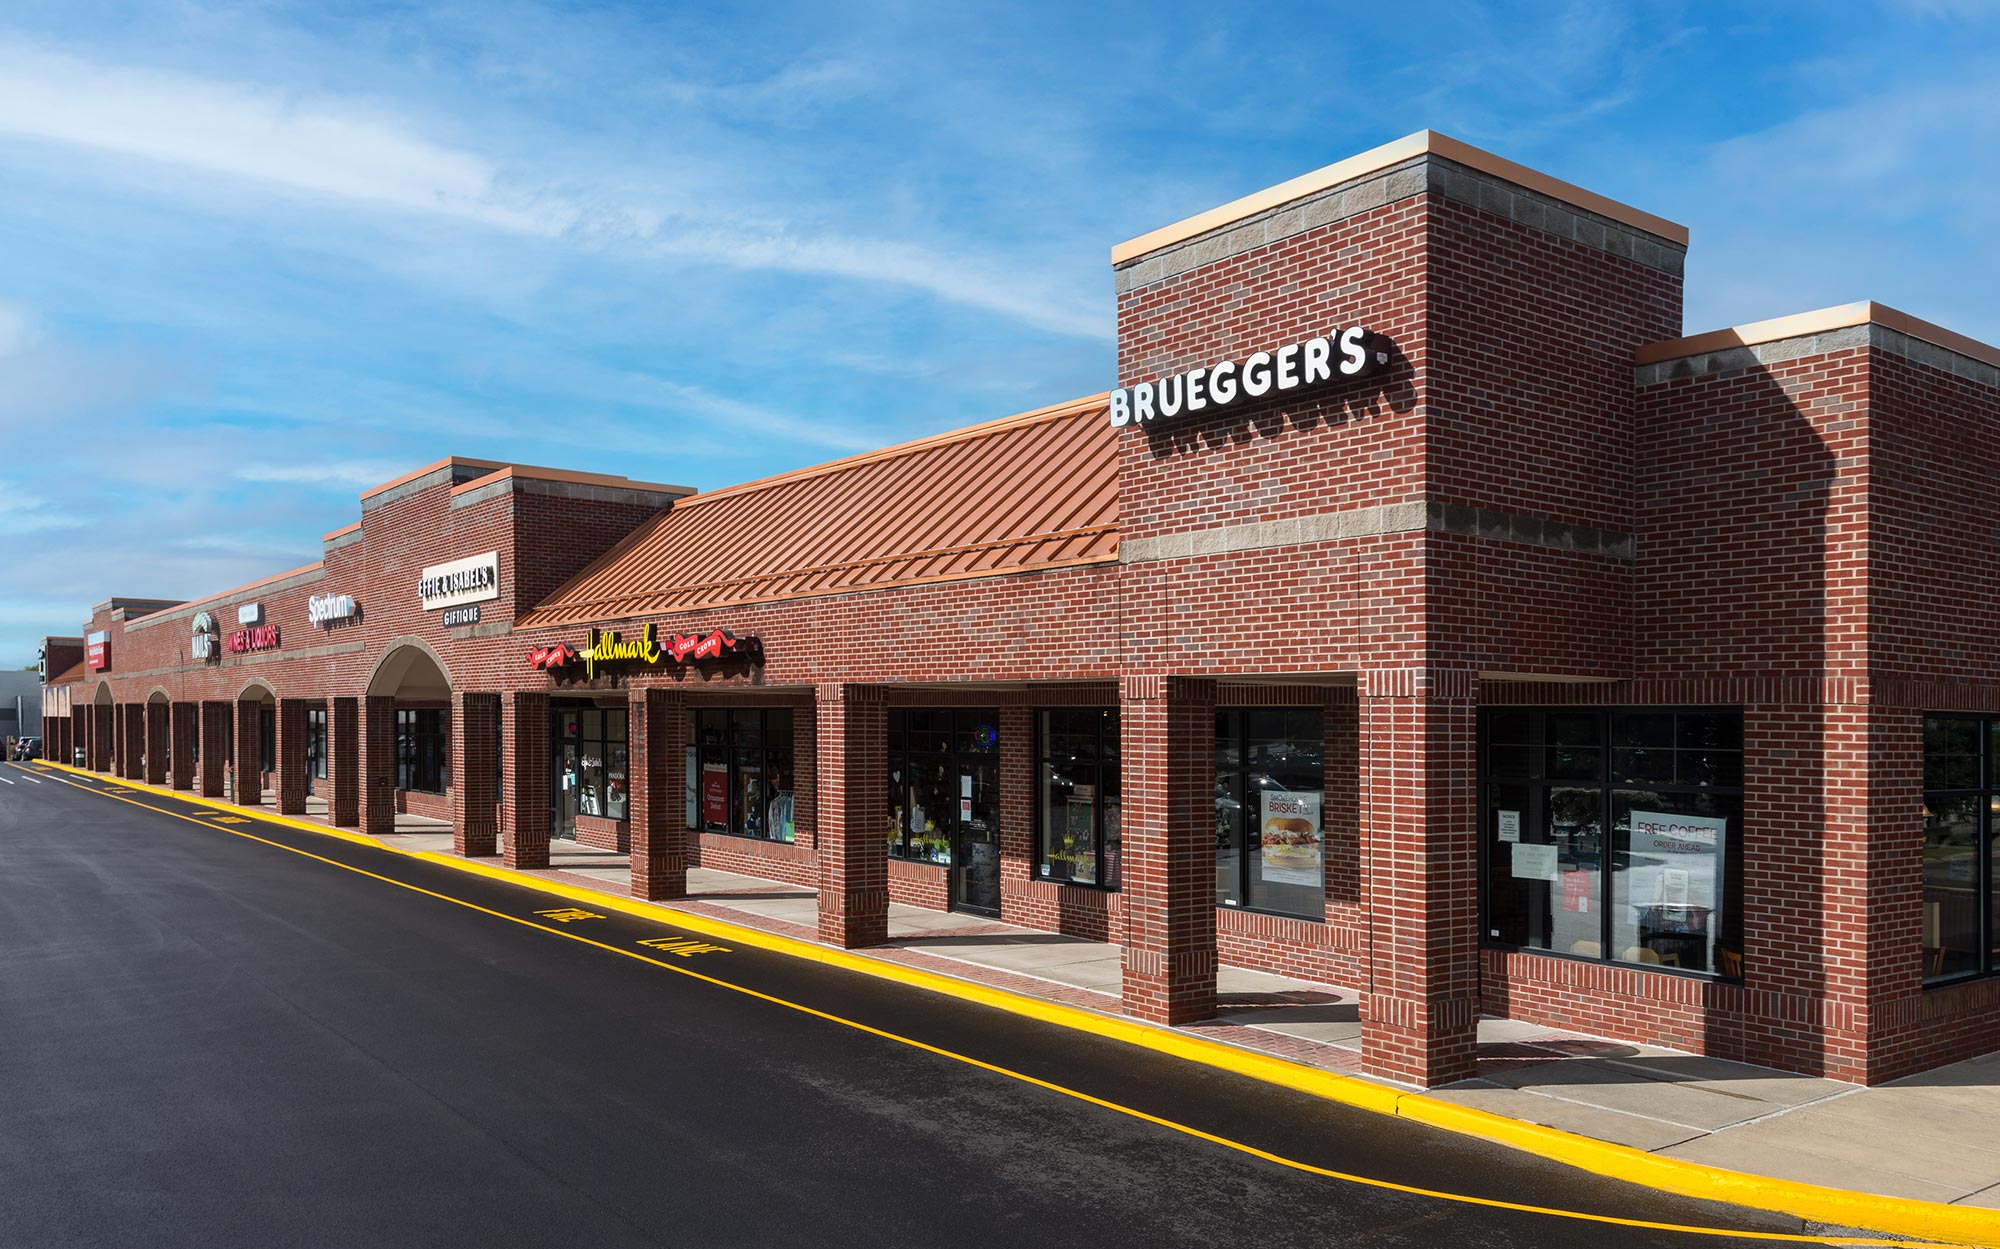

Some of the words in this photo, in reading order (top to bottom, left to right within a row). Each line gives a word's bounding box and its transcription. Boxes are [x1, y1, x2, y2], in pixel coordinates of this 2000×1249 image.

[1109, 325, 1368, 429] BRUEGGER'S
[418, 576, 440, 597] EFFIE
[442, 575, 448, 593] &
[450, 566, 488, 591] ISABEL'S
[309, 592, 348, 629] Spectrum
[444, 607, 478, 626] GIFTIQUE
[579, 623, 660, 680] Hallmark
[679, 639, 695, 651] GOLD
[696, 638, 717, 655] CROWN
[1638, 821, 1665, 836] FREE
[1669, 824, 1718, 840] COFFEE
[1653, 839, 1676, 849] ORDER
[1677, 842, 1702, 852] AHEAD
[1046, 847, 1092, 867] Hallmak
[635, 936, 734, 958] LANE
